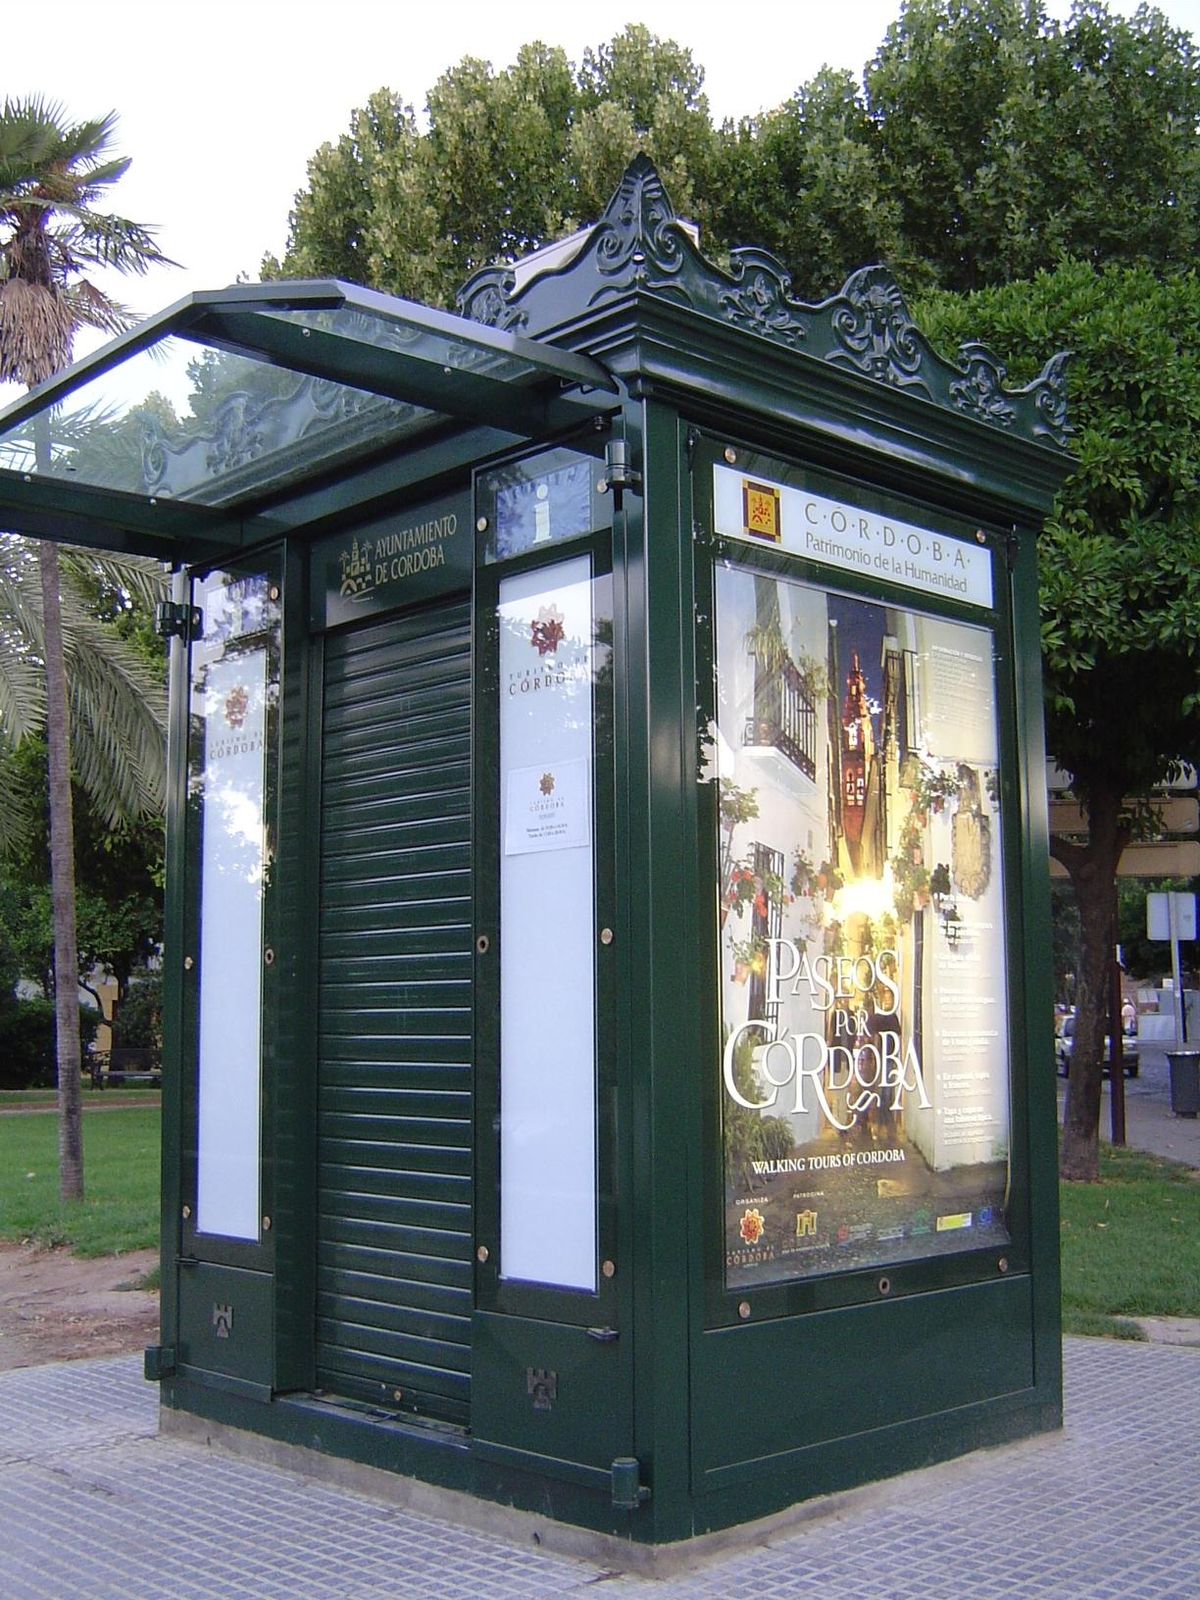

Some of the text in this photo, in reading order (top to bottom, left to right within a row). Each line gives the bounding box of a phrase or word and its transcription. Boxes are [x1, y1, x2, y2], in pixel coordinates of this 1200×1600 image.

[375, 514, 457, 560] AYUNTAMIENTO
[533, 484, 552, 543] i
[375, 562, 388, 585] DE
[806, 532, 967, 593] Patrimonio de la Humanidad
[766, 938, 899, 1016] PASEOS
[835, 1008, 872, 1037] POR
[724, 1020, 933, 1130] CÓRDOBA
[752, 1157, 806, 1174] WALKING
[808, 1153, 842, 1169] TOURS
[843, 1152, 857, 1166] OF
